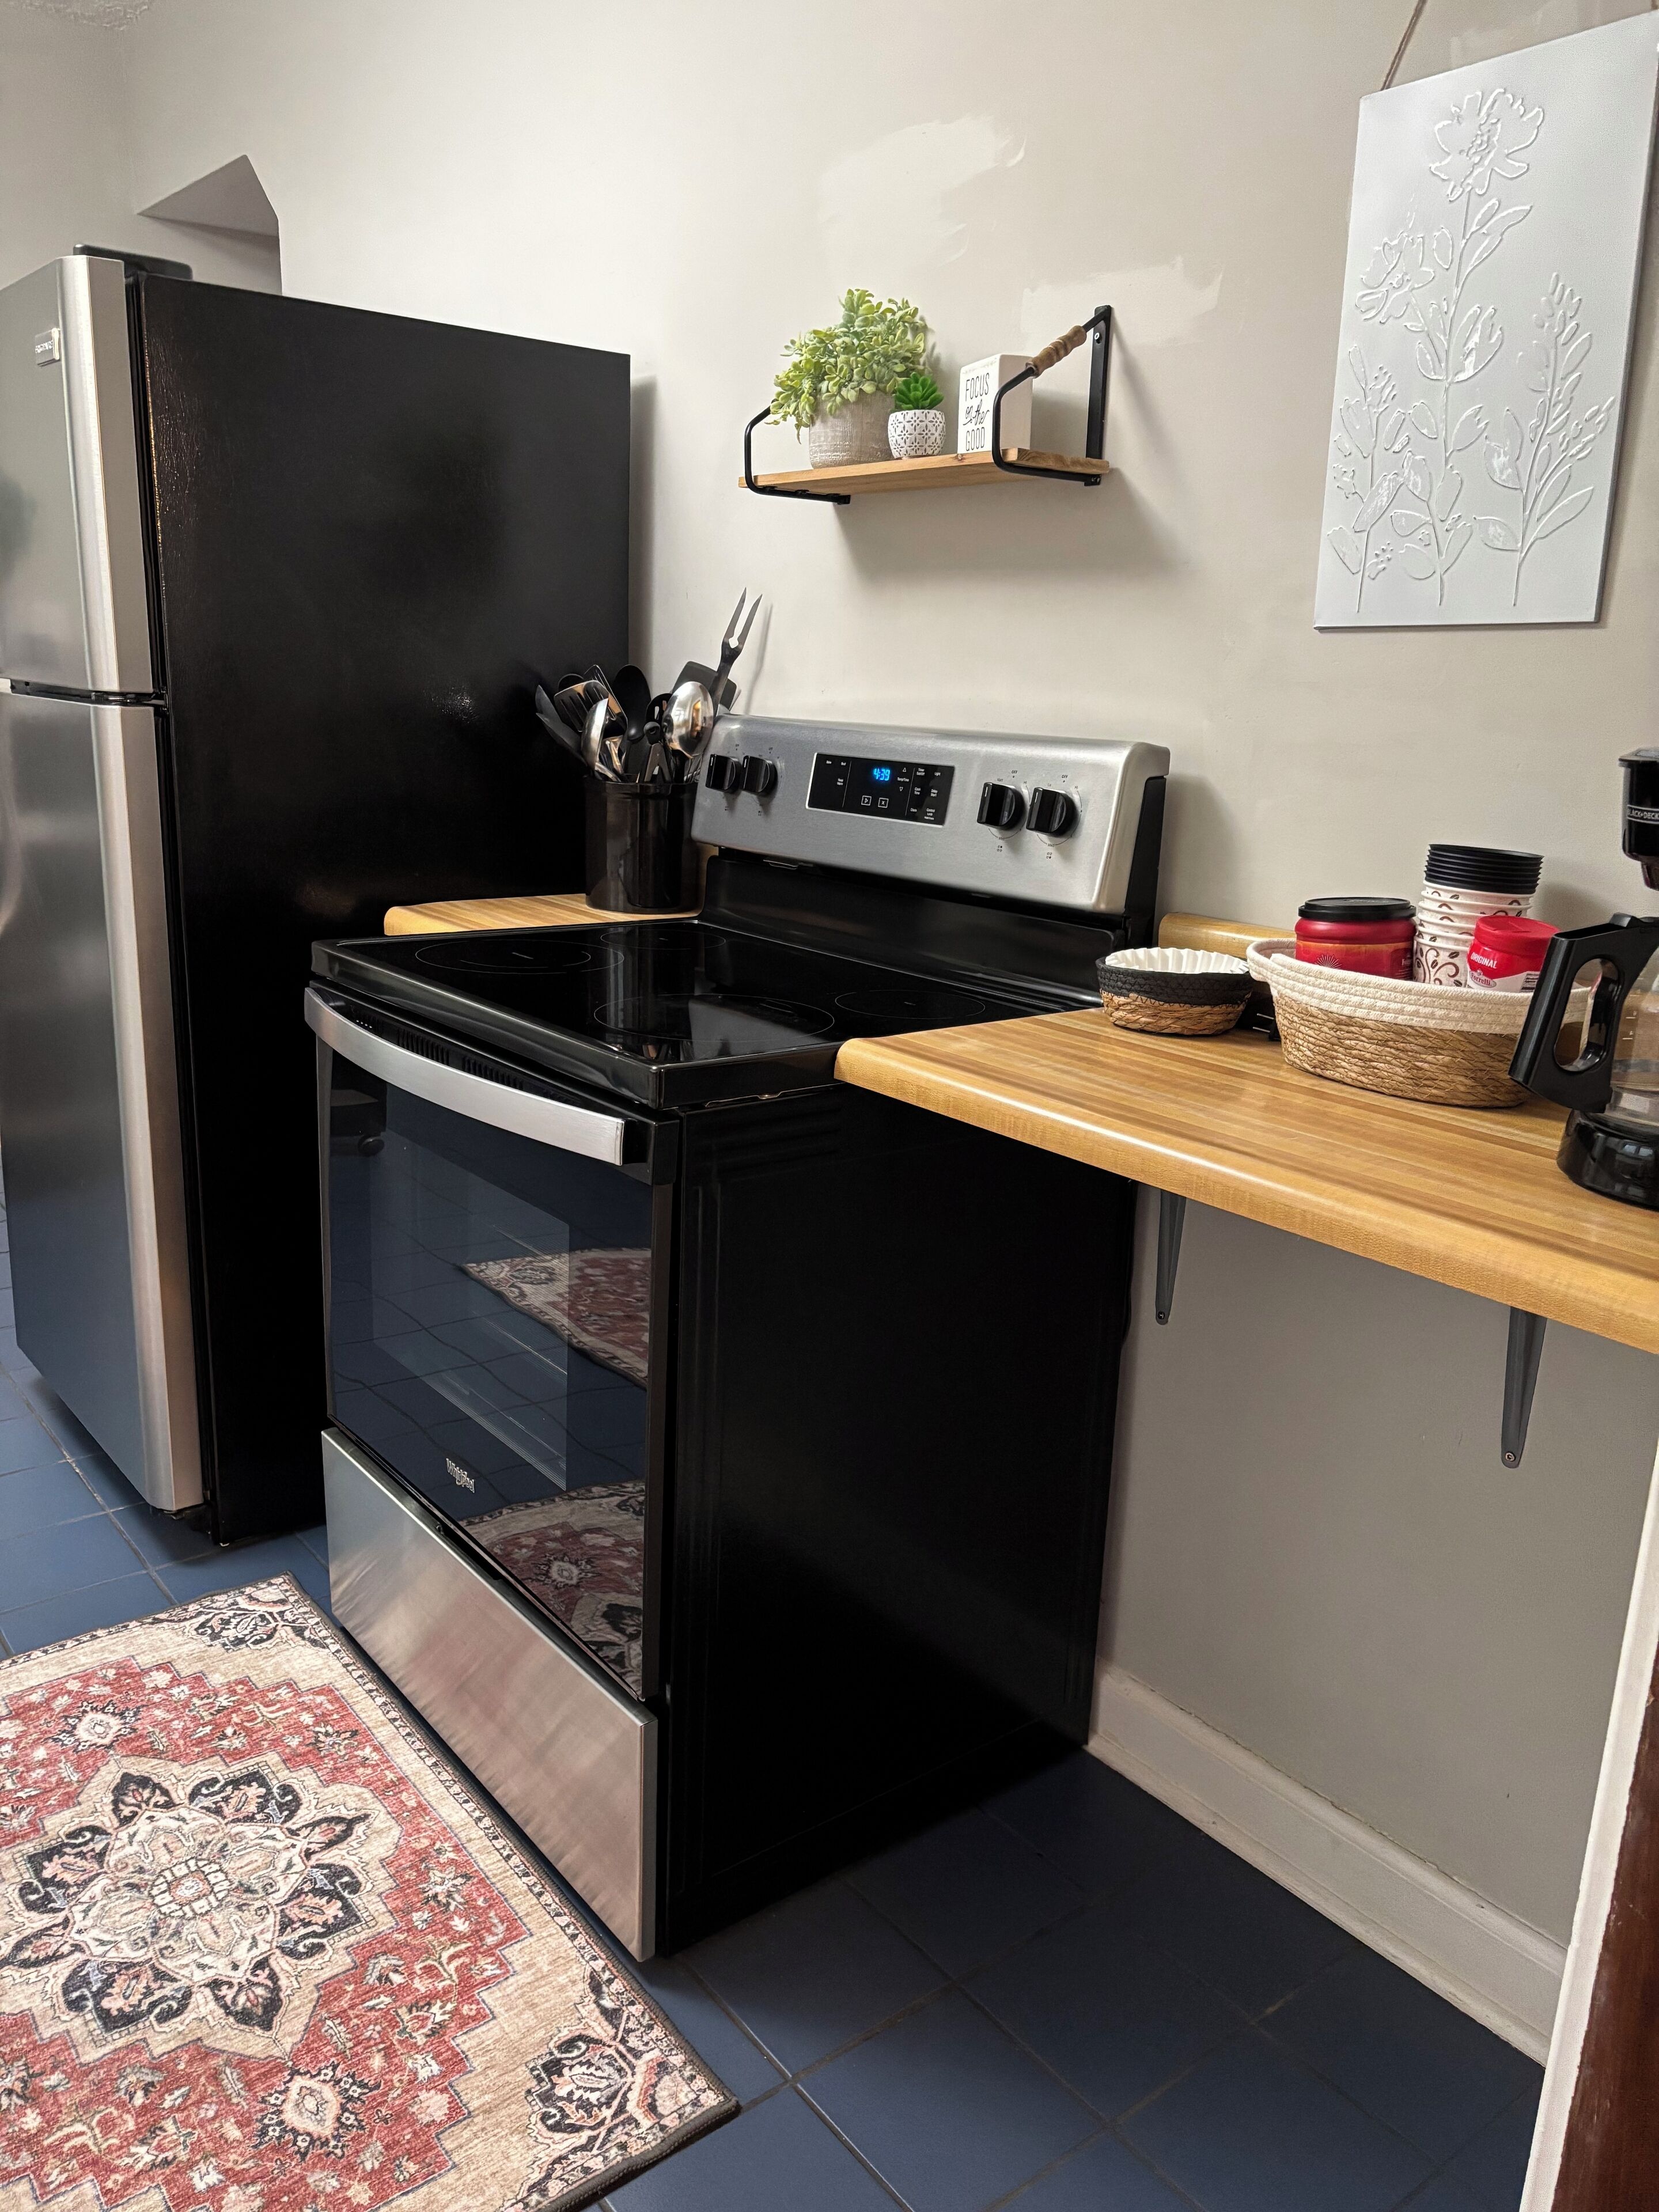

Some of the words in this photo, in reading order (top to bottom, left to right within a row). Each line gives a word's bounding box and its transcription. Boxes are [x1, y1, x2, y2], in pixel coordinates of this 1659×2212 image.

[965, 372, 990, 402] FOCUS
[973, 399, 990, 426] the
[965, 426, 985, 452] GOOD
[873, 767, 890, 781] 4:39
[1470, 952, 1498, 969] ORIGINAL
